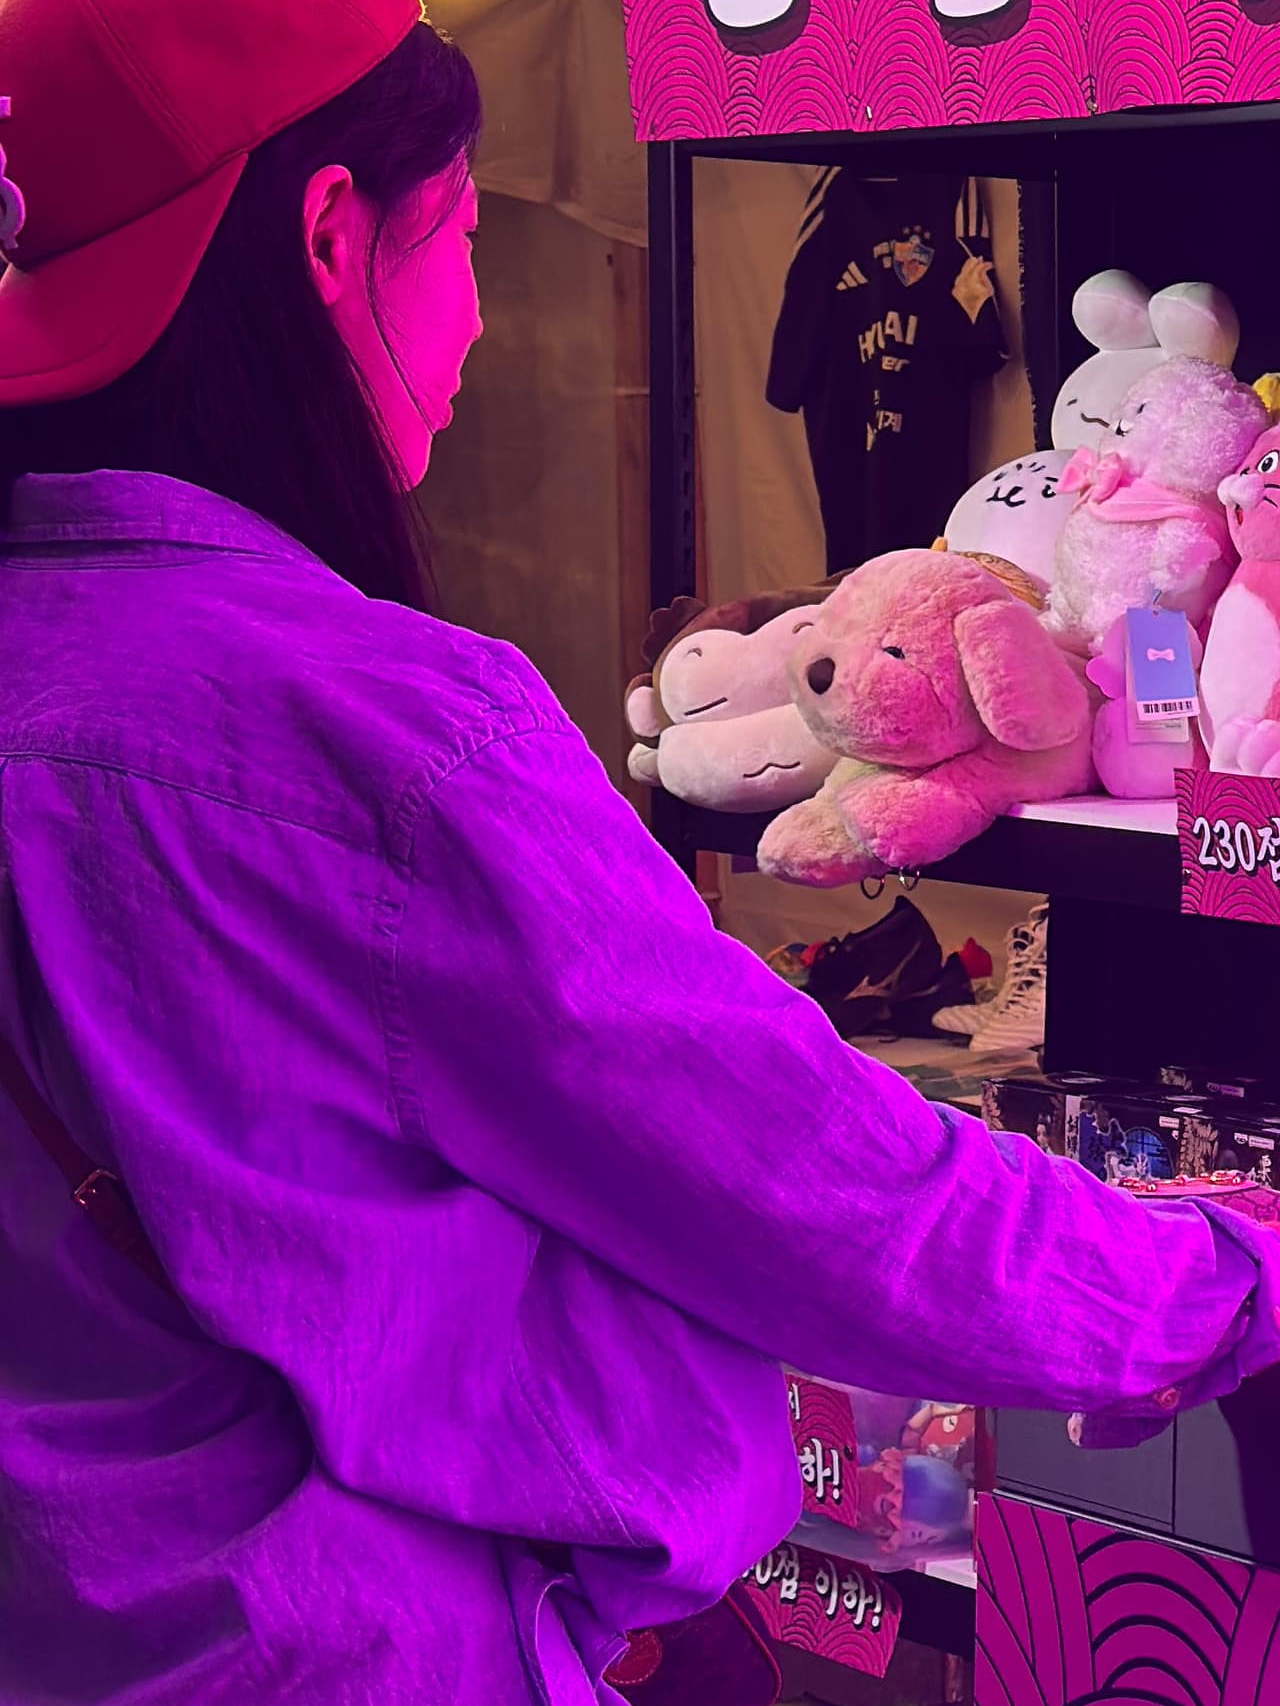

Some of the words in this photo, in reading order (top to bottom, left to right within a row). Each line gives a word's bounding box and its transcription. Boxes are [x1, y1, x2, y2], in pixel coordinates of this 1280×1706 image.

[799, 1437, 840, 1500] 하!
[742, 1544, 799, 1600] 0점
[815, 1558, 883, 1627] 이하!
